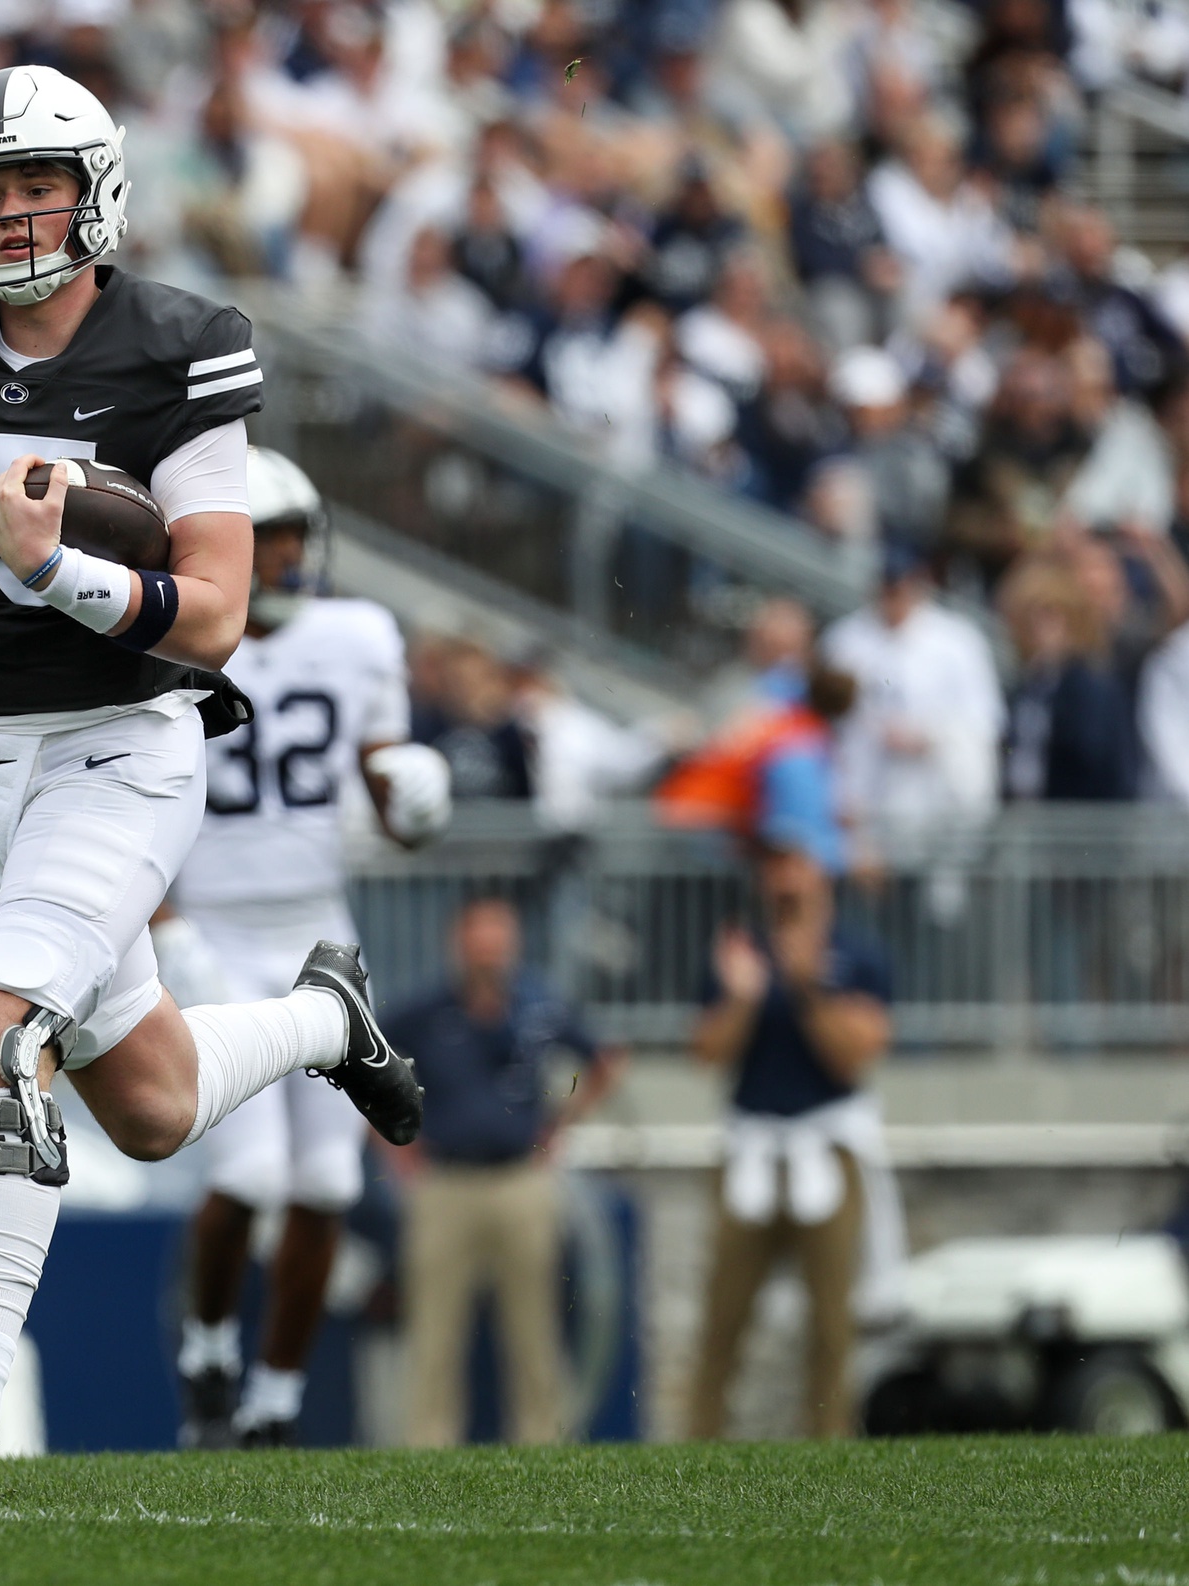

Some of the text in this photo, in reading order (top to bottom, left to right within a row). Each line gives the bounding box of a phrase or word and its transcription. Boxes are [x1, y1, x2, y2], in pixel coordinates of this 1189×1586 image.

[106, 480, 158, 512] VAPOR ELITE
[76, 589, 111, 600] WE ARE
[206, 687, 336, 815] 32
